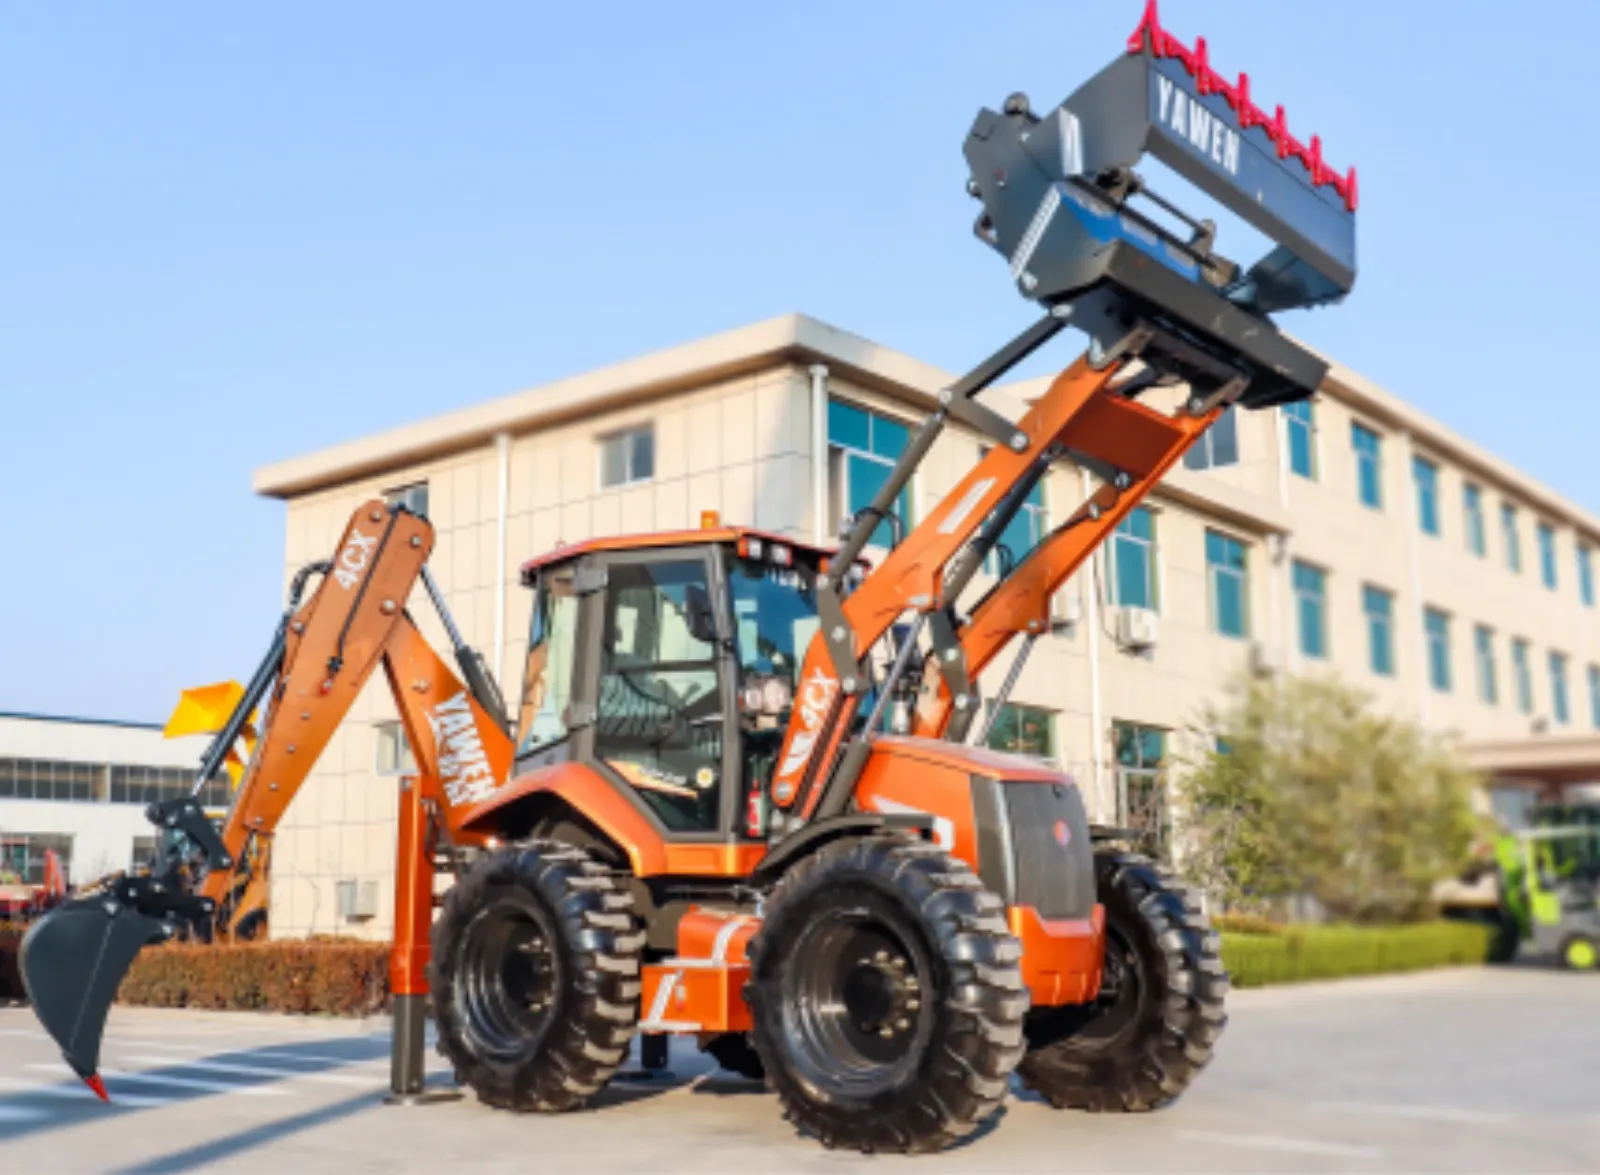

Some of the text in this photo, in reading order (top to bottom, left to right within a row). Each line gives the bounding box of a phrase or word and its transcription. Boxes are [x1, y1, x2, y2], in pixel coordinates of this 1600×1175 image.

[1156, 73, 1240, 175] YAWEN
[335, 528, 378, 590] 4CX
[434, 689, 497, 802] YAWEN
